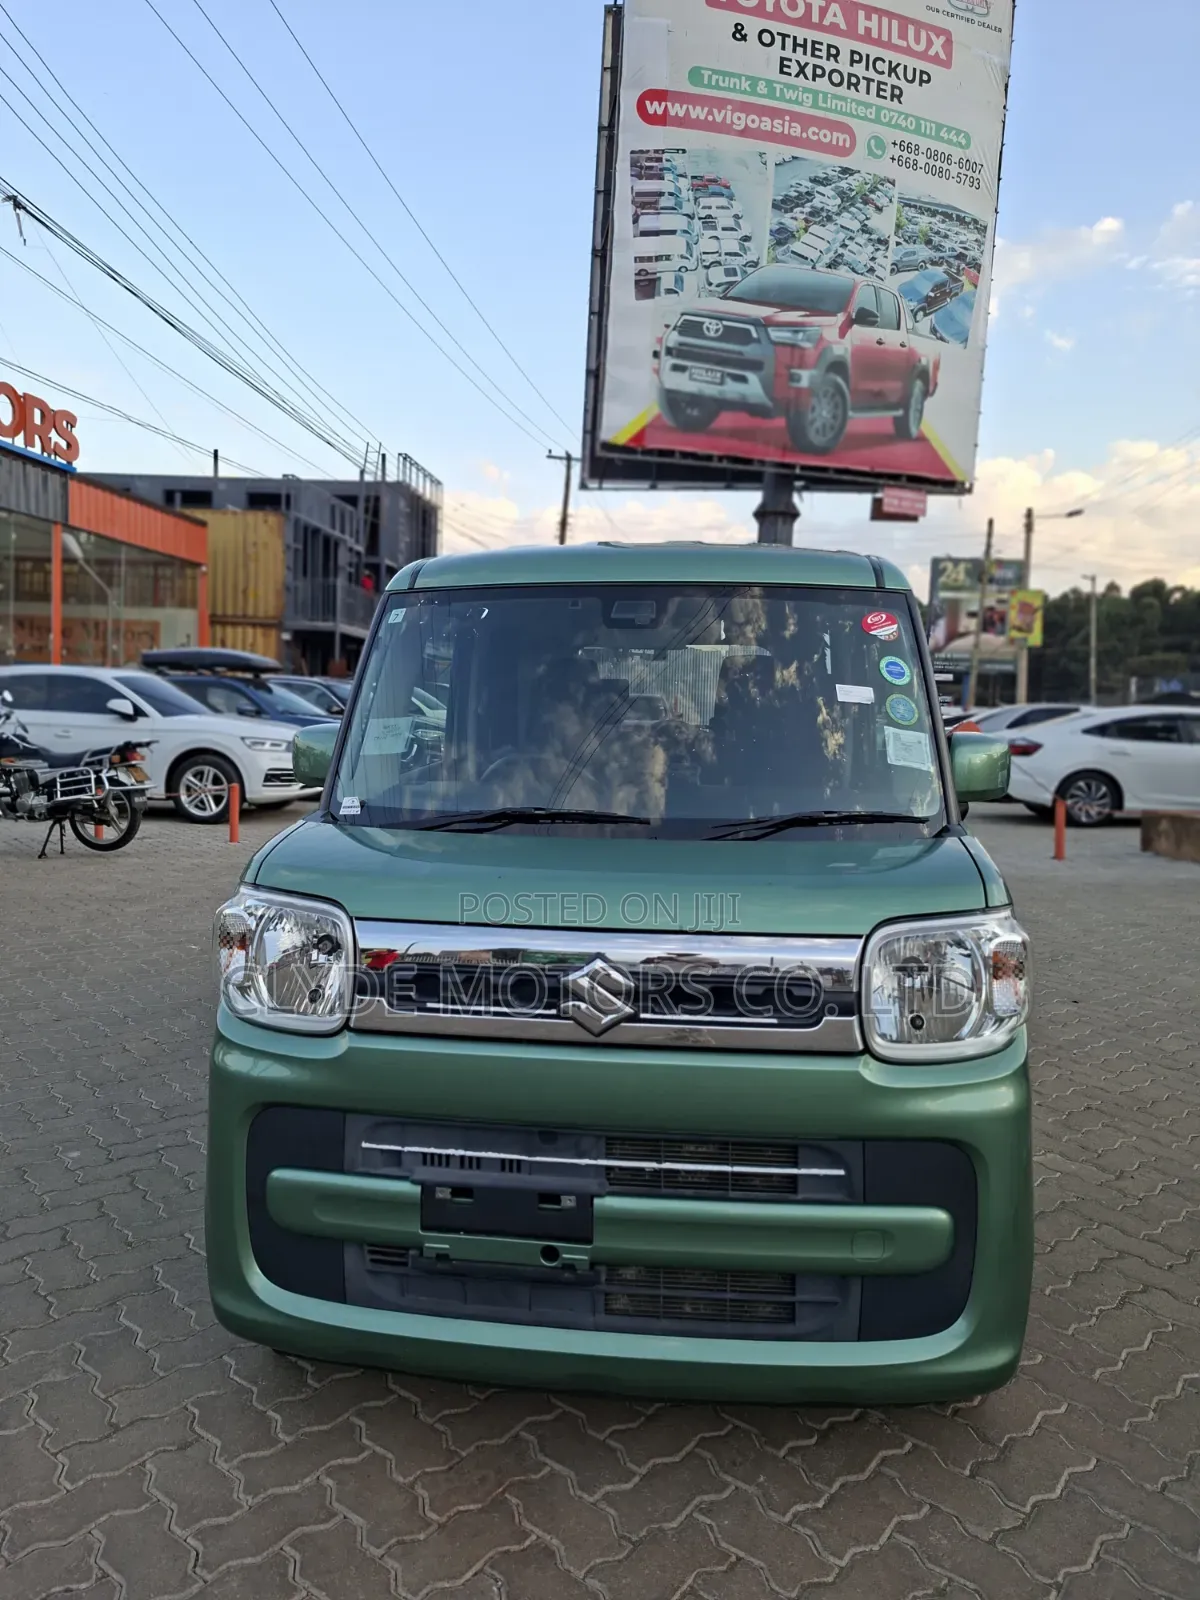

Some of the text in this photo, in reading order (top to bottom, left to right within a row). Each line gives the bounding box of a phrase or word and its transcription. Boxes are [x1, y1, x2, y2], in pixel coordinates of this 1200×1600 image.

[714, 0, 947, 61] YOTA HILUX
[925, 5, 1003, 34] OUR CERTIFIED DEALER
[731, 22, 932, 88] & OTHER PICKUP
[779, 56, 904, 105] EXPORTER
[645, 100, 850, 149] www.vigoasia.com
[701, 70, 967, 147] Trunk & Twig Limited 0740 111 444
[889, 154, 982, 191] +668-0080-5793
[891, 139, 984, 175] +668-0806-6007
